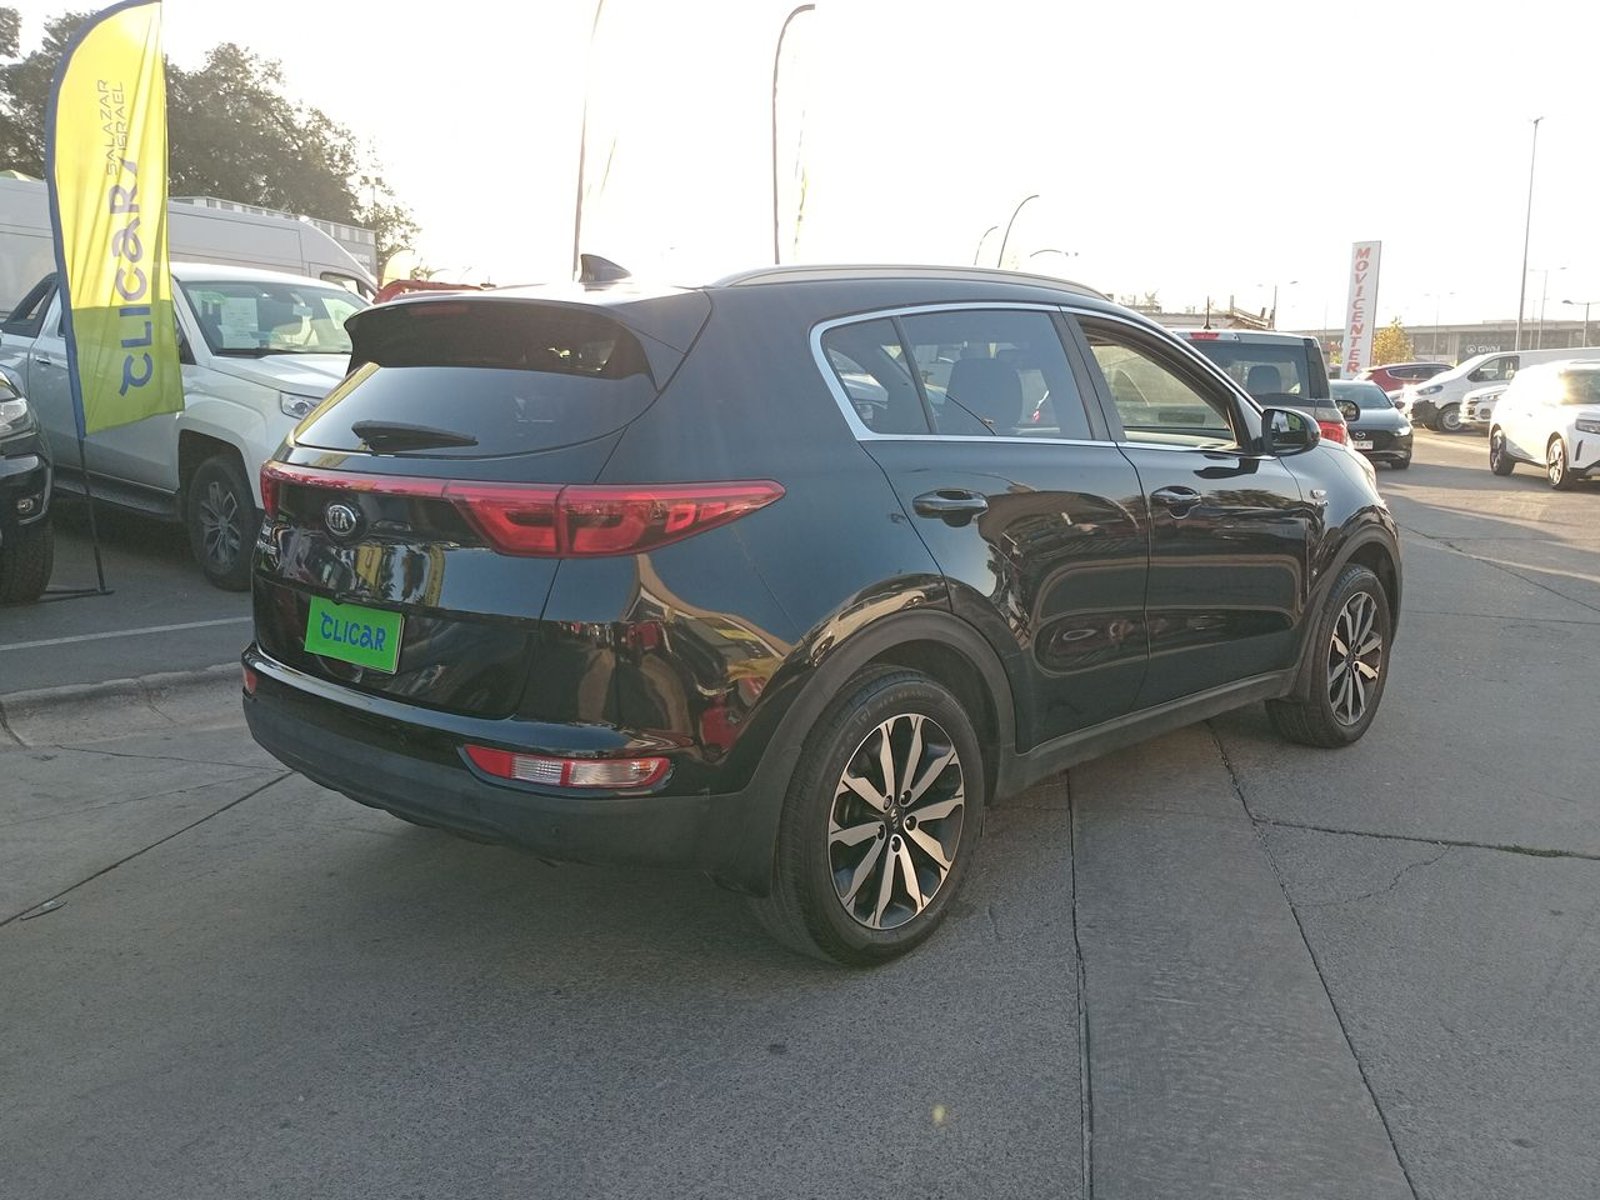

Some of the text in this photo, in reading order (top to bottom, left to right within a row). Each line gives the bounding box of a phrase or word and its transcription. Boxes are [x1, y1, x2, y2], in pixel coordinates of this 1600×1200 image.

[97, 79, 118, 176] SALAZAR
[114, 84, 128, 151] ISRAEL
[1346, 247, 1371, 373] MOVICENTER
